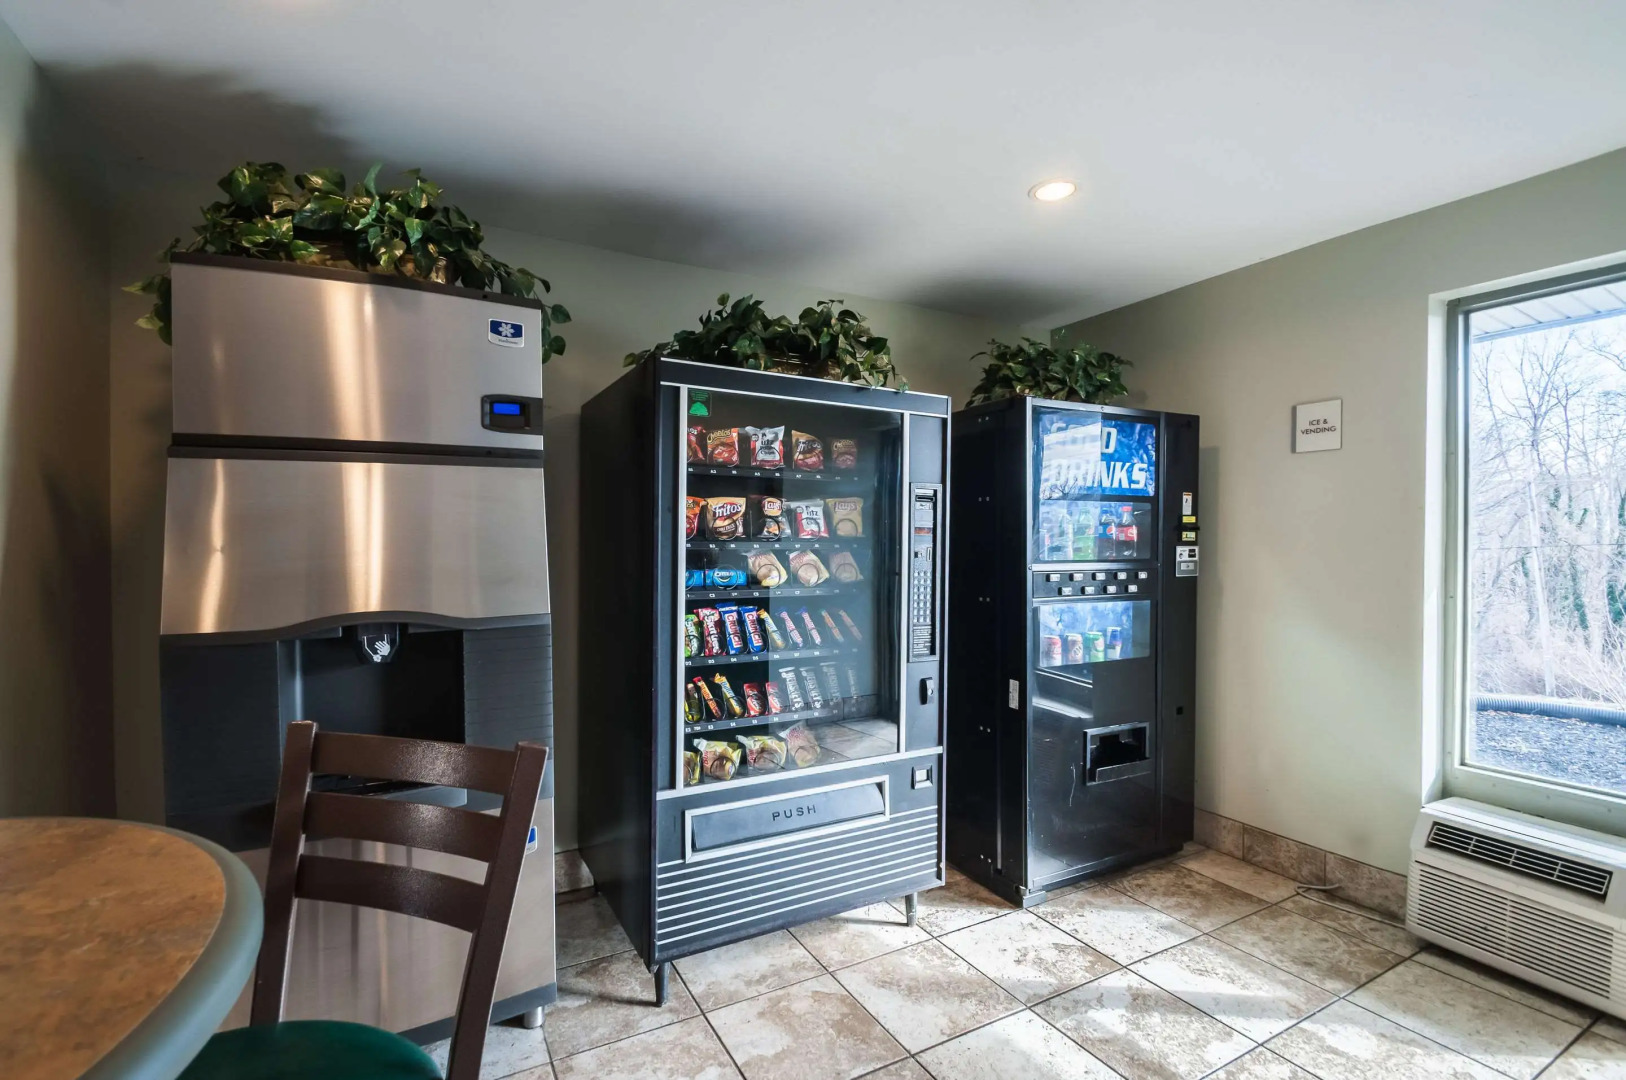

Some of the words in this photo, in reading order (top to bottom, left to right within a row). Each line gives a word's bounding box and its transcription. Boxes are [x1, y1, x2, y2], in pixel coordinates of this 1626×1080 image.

[1300, 426, 1337, 435] VENDING
[1308, 418, 1321, 426] ICE
[1050, 423, 1117, 454] CD
[712, 502, 742, 517] Fritos
[726, 614, 743, 647] CRUNCH
[746, 613, 763, 646] CRUNCH
[771, 804, 817, 822] PUSH
